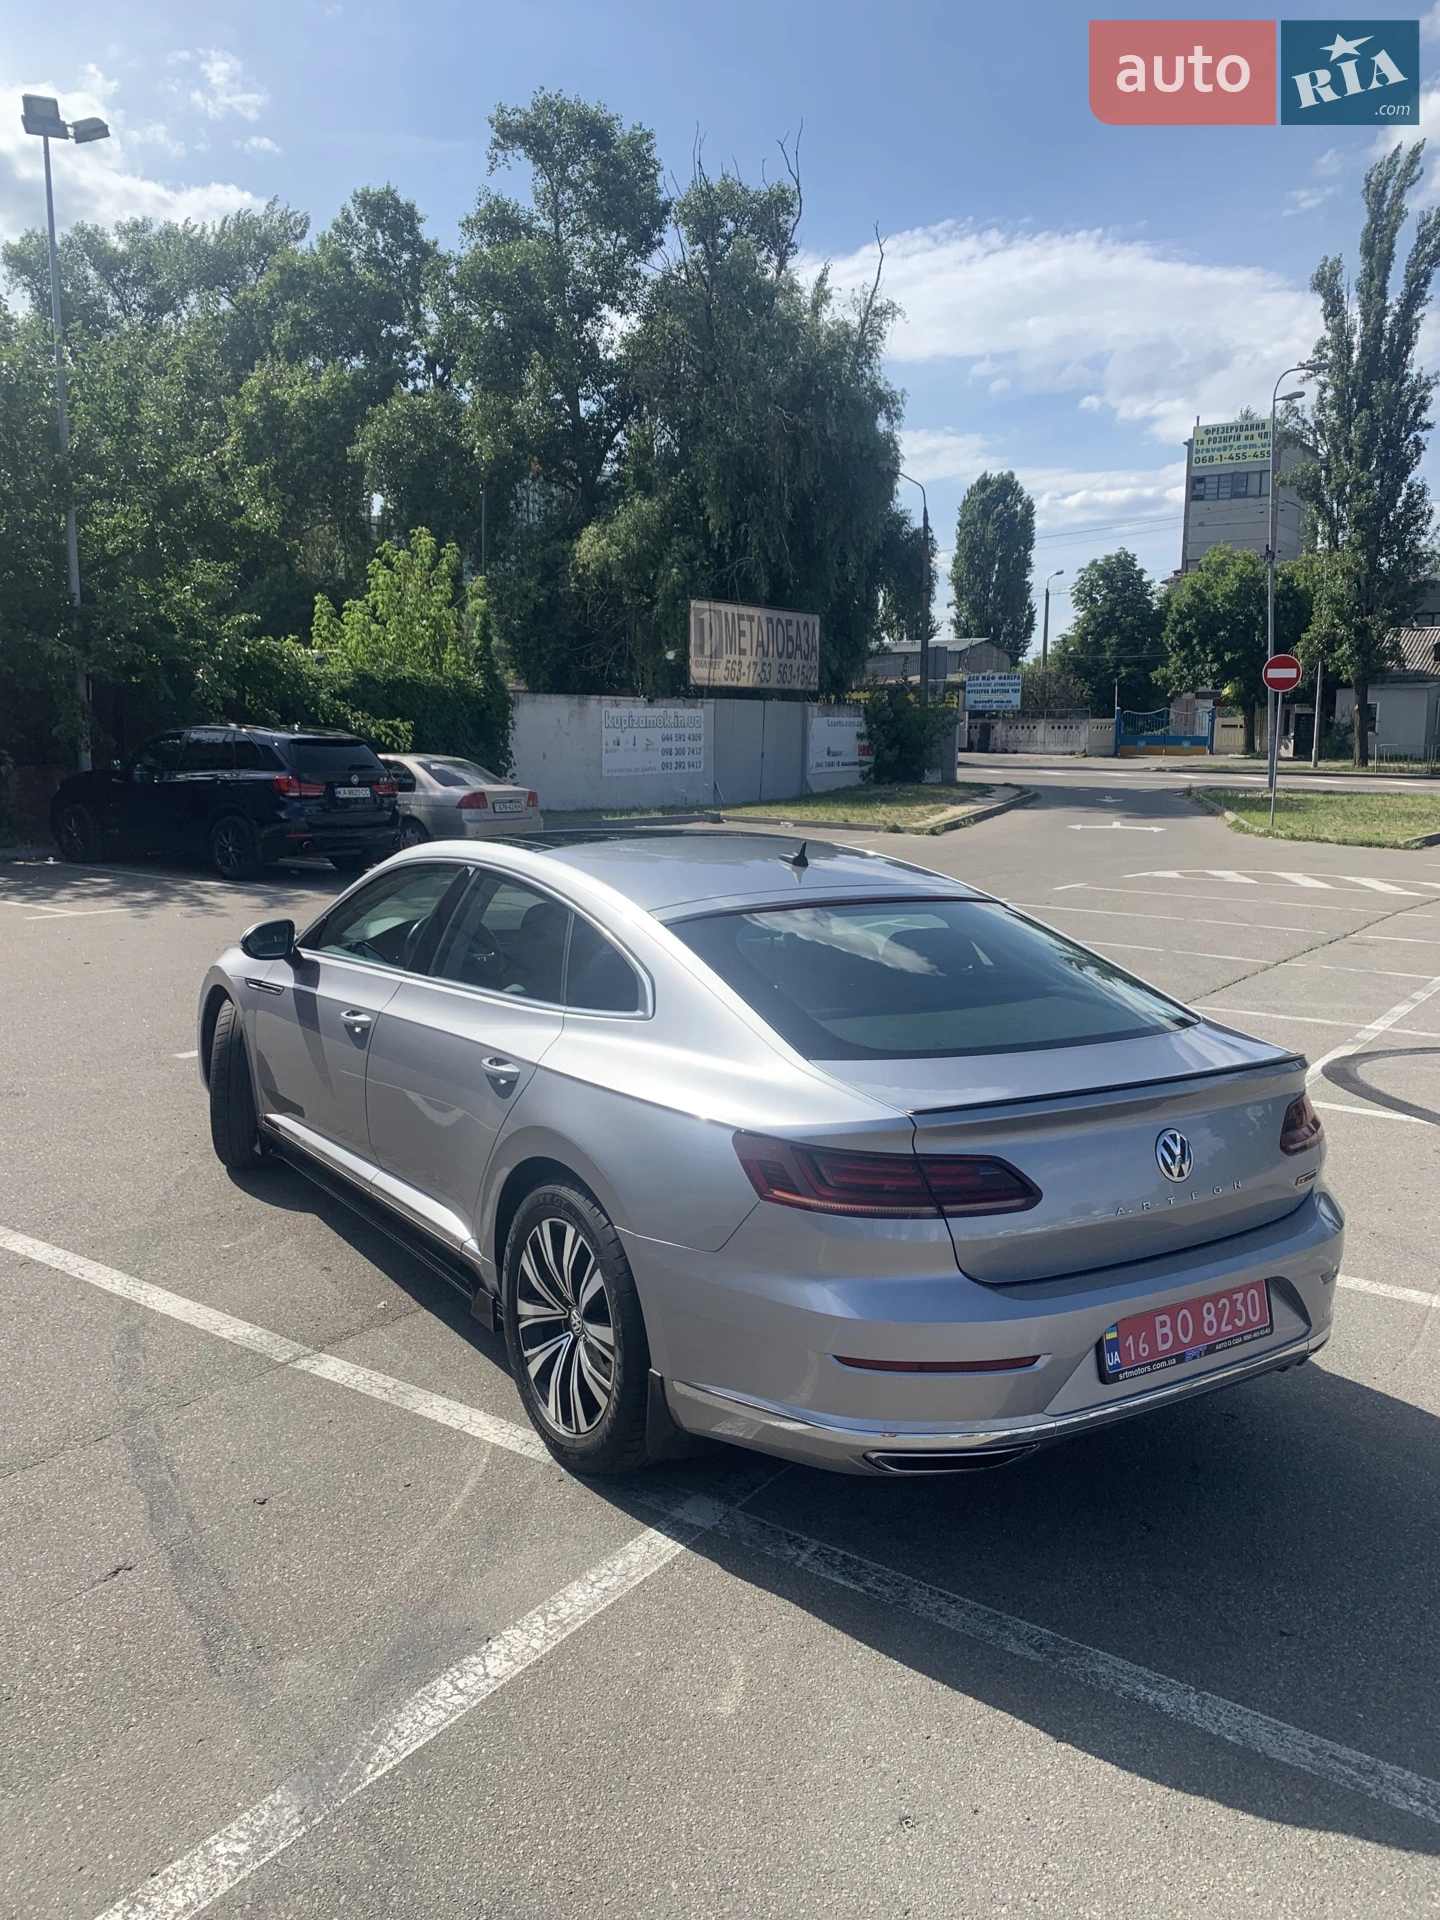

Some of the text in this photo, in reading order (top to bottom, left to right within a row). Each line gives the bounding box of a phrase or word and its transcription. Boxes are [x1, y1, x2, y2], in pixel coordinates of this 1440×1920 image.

[1204, 422, 1266, 435] ФРЕЗЕРУВАННЯ
[1208, 432, 1241, 445] РОЗКРІЙ
[1194, 450, 1271, 464] 068-1-455-455
[723, 611, 818, 662] МЕТАЛОБАЗА
[723, 659, 772, 682] 563-17-53
[605, 710, 702, 733] kupizamok.in.ua
[661, 733, 673, 742] 044
[674, 733, 686, 742] 592
[1116, 1181, 1242, 1216] ARTEON
[1124, 1288, 1261, 1361] 16 BO 8230
[1106, 1351, 1121, 1366] UA
[1118, 1357, 1177, 1381] srtmotors.com.ua
